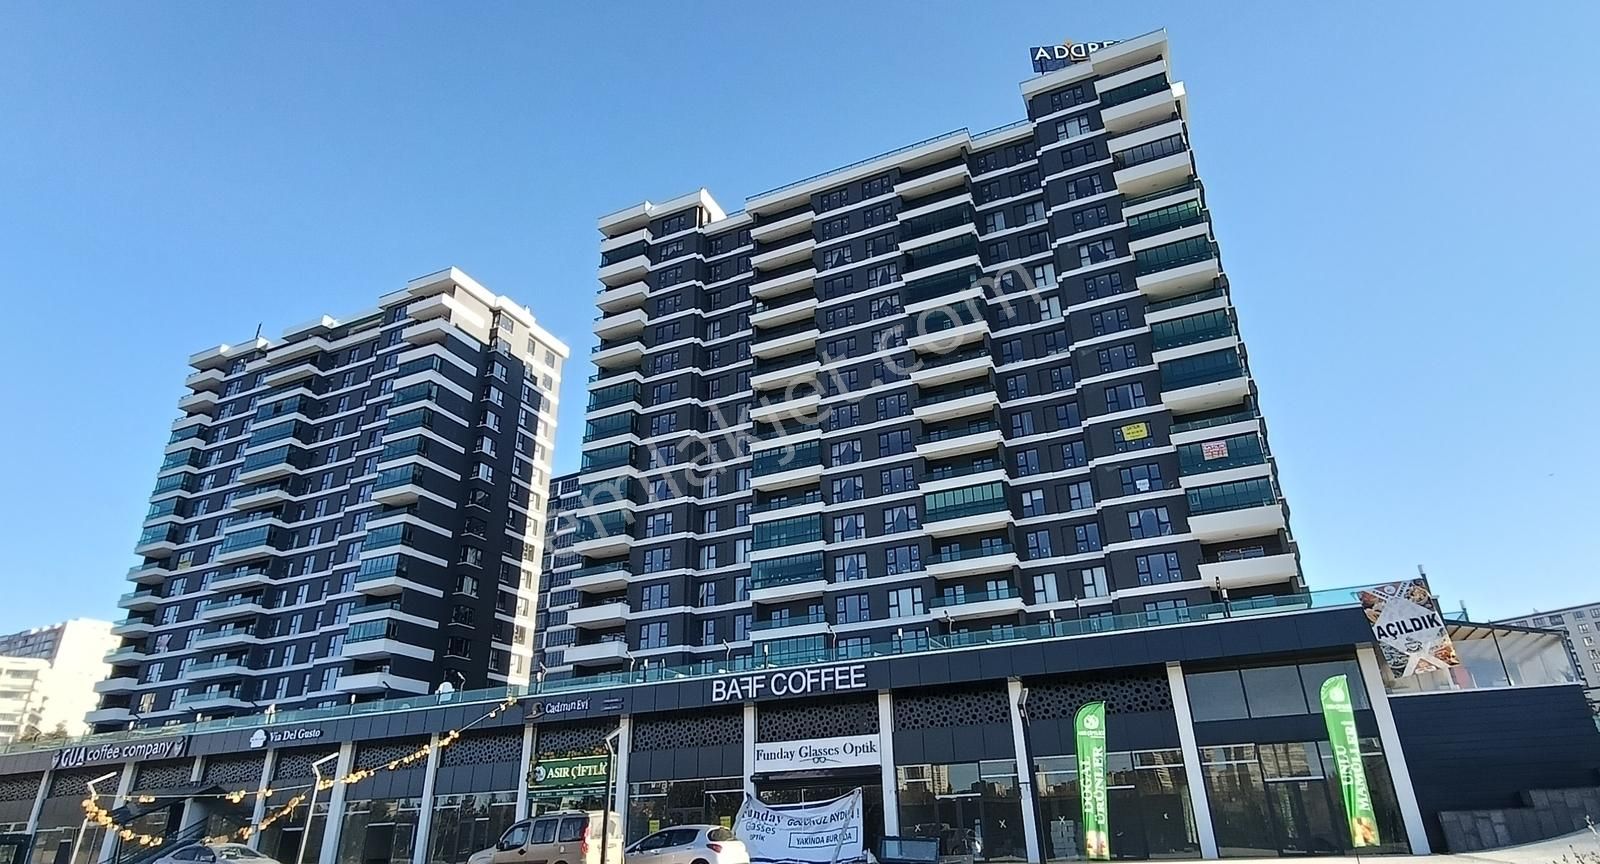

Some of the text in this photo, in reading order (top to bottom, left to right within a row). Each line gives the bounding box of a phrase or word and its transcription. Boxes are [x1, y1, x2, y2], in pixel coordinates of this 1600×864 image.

[1376, 613, 1442, 640] AÇILDIK
[712, 664, 867, 702] BAFF COFFEE
[282, 729, 297, 741] Del
[298, 728, 321, 739] Gusto
[60, 740, 173, 767] GUA coffee company
[756, 740, 878, 761] Funday Glasses Optik
[546, 766, 570, 779] ASIR
[1092, 745, 1106, 825] ÜRÜNLER
